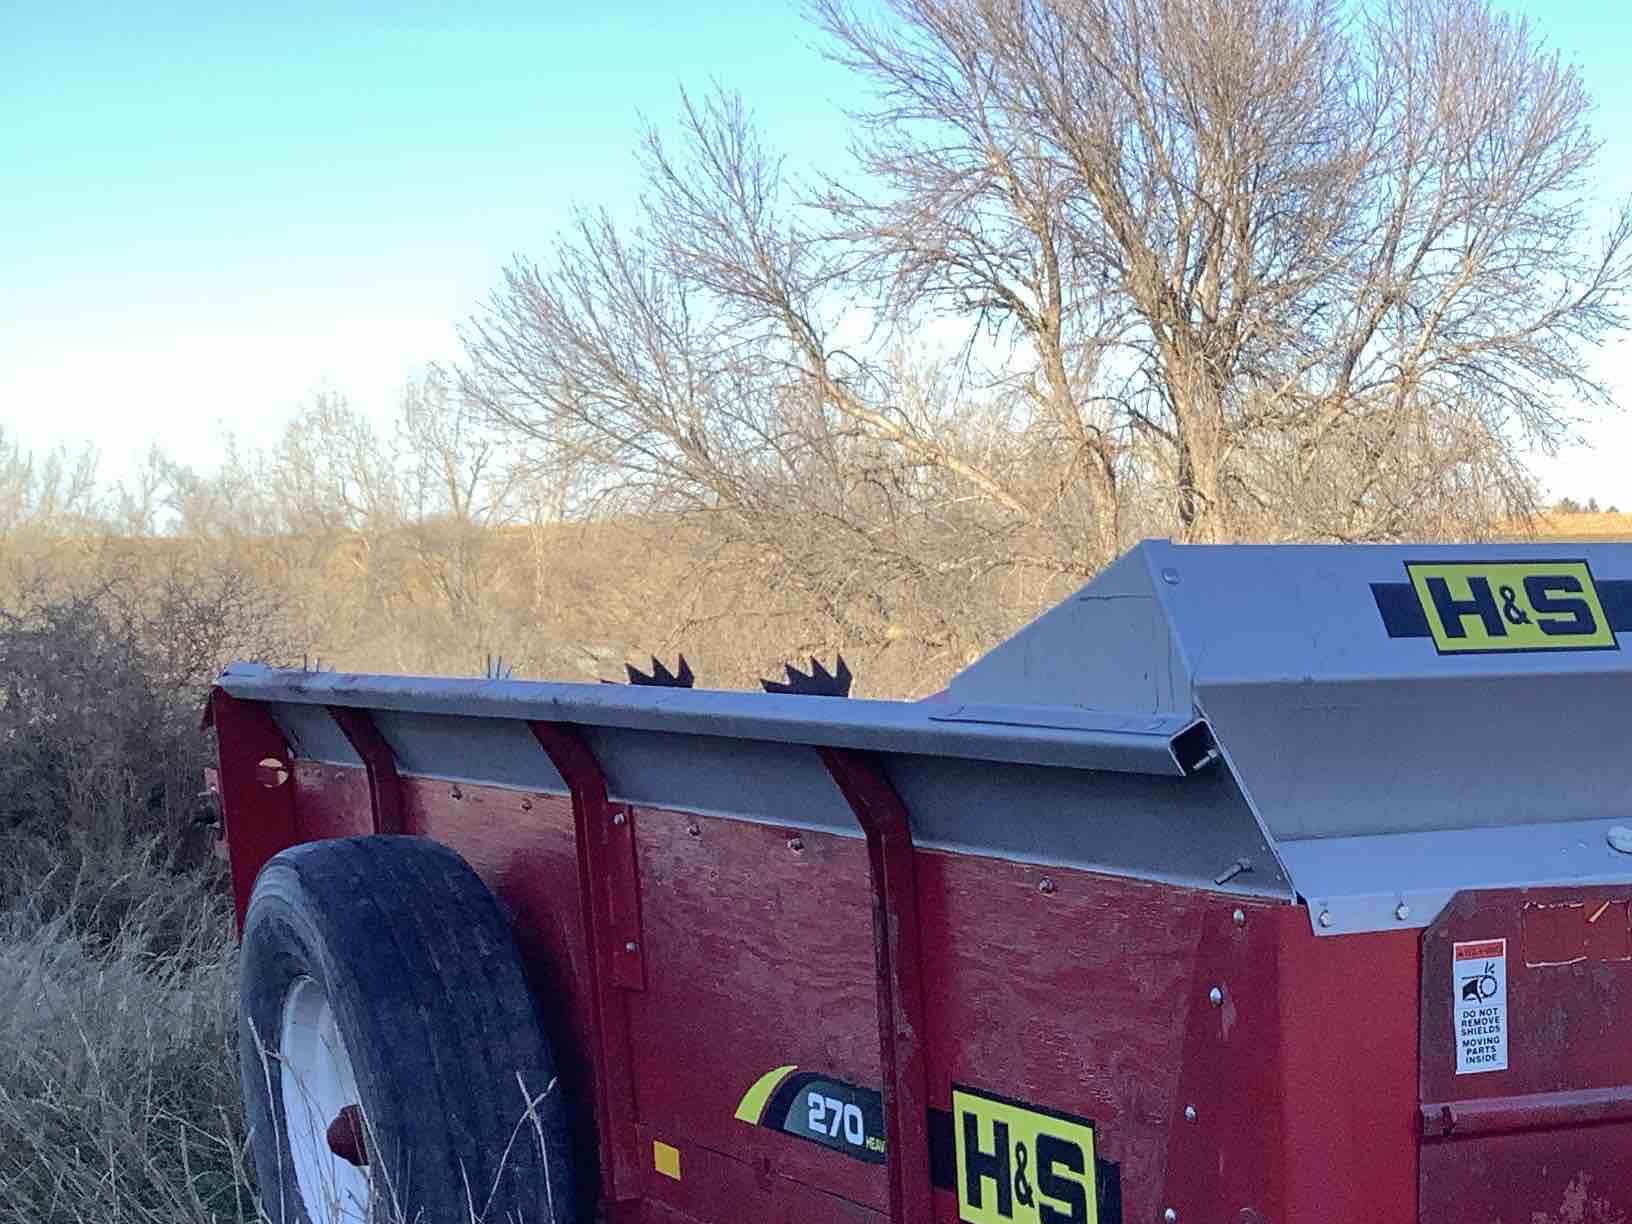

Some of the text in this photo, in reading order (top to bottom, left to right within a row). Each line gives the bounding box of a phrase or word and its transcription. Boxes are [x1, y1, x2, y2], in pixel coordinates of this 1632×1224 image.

[1424, 575, 1598, 638] H&S
[1463, 1007, 1498, 1019] DO NOT
[1461, 1016, 1501, 1028] REMOVE
[1461, 1025, 1501, 1036] SHIELDS
[1462, 1036, 1500, 1047] MOVING
[1466, 1046, 1497, 1056] PARTS
[1465, 1054, 1497, 1064] INSIDE
[807, 1091, 864, 1146] 270
